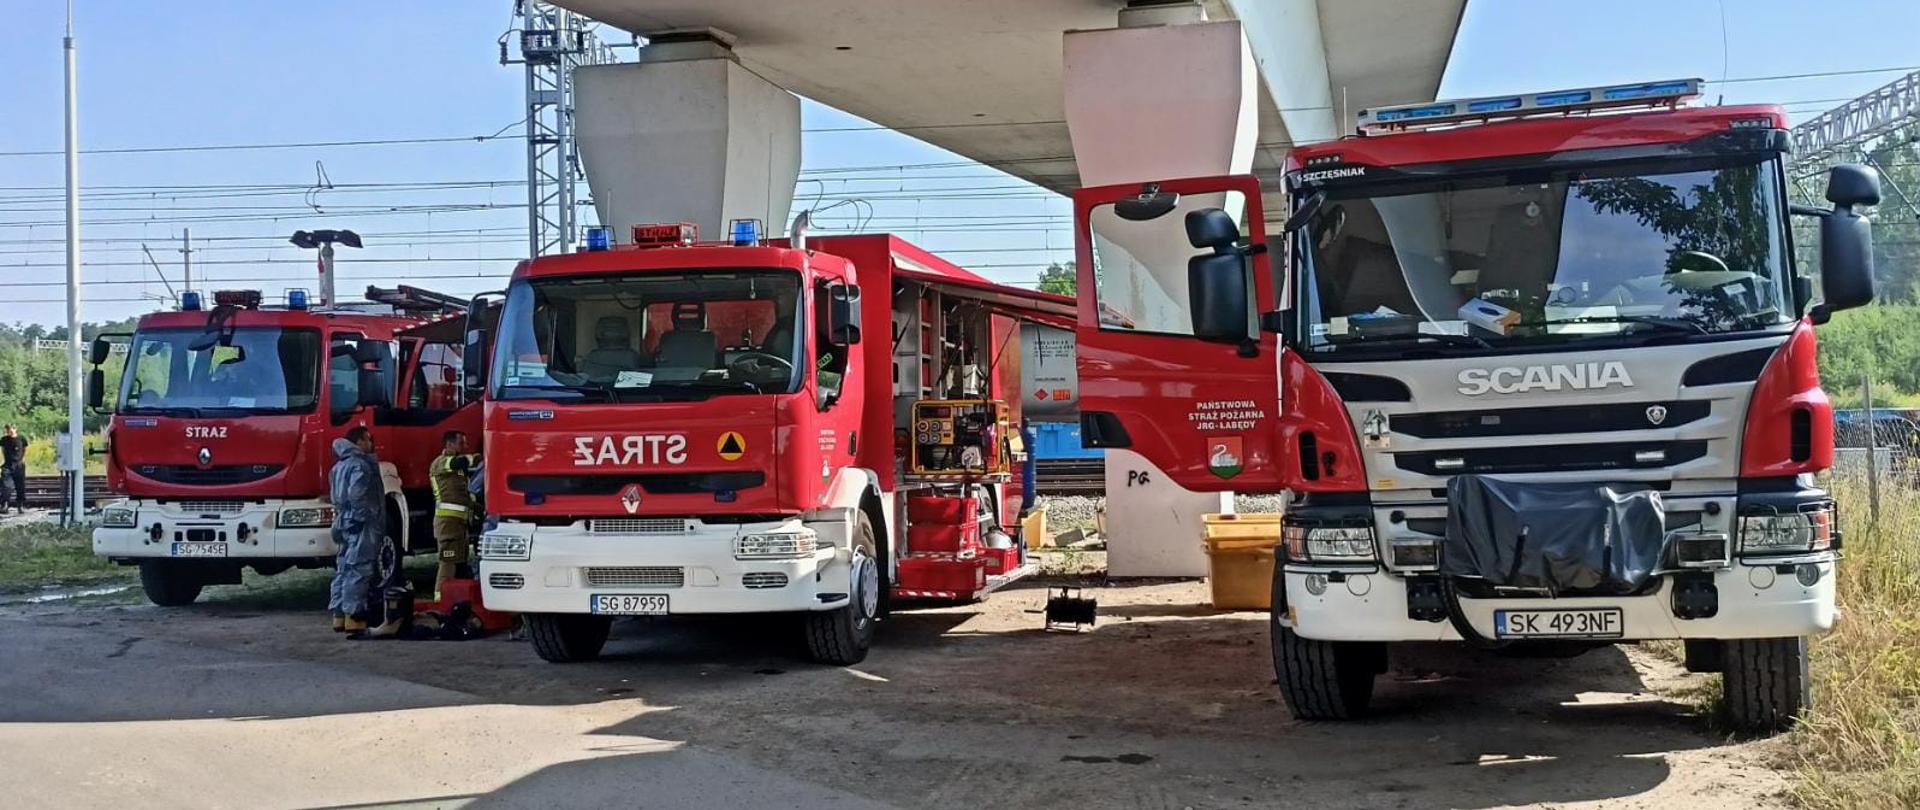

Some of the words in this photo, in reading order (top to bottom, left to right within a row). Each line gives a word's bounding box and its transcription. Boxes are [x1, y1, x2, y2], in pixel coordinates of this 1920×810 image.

[1458, 361, 1634, 395] SCANIA
[600, 596, 619, 611] SG
[623, 596, 665, 611] 87959
[1510, 613, 1540, 633] SK
[1549, 611, 1617, 632] 493NF
